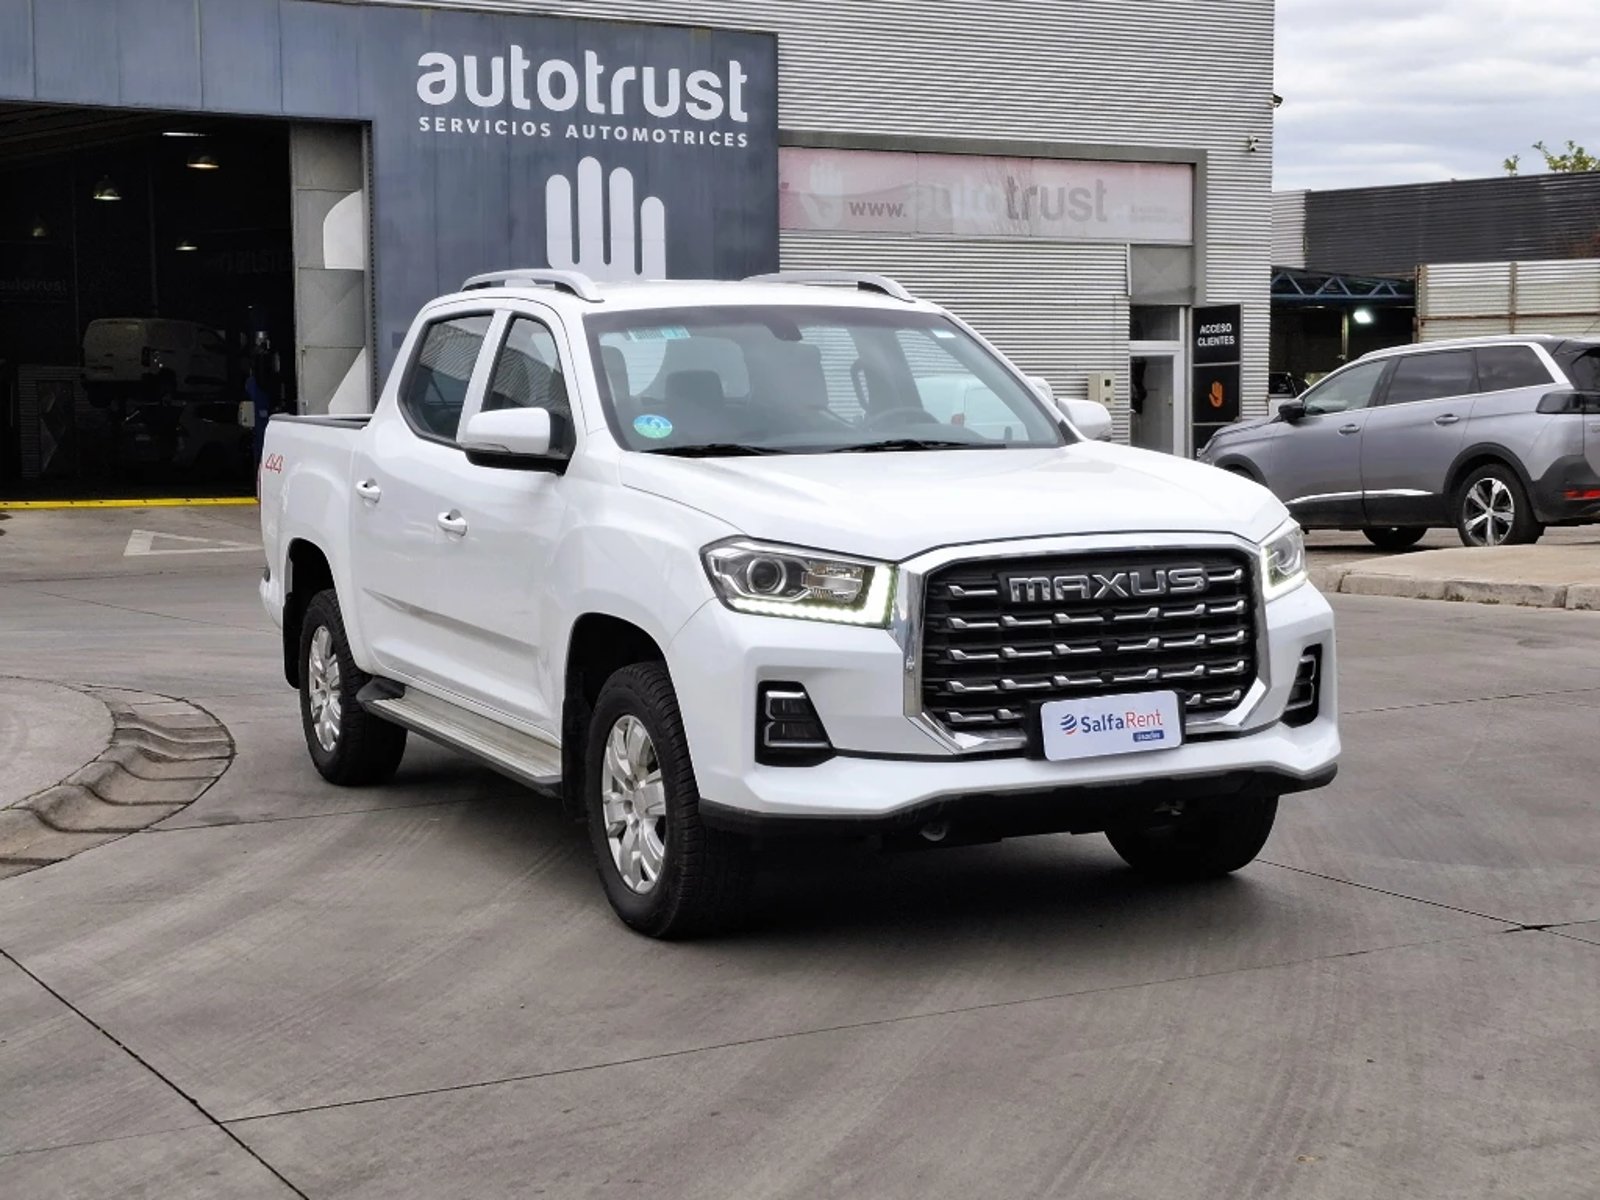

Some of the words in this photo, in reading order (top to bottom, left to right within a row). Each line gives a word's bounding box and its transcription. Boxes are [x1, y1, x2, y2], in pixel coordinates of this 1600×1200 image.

[416, 45, 748, 122] autotrust
[418, 117, 551, 137] SERVICIOS
[565, 124, 748, 147] AUTOMOTRICES
[1197, 335, 1235, 346] CLIENTES
[1199, 323, 1232, 334] ACCESO
[1009, 567, 1206, 602] MAXUS
[1080, 709, 1163, 733] SalfaRent
